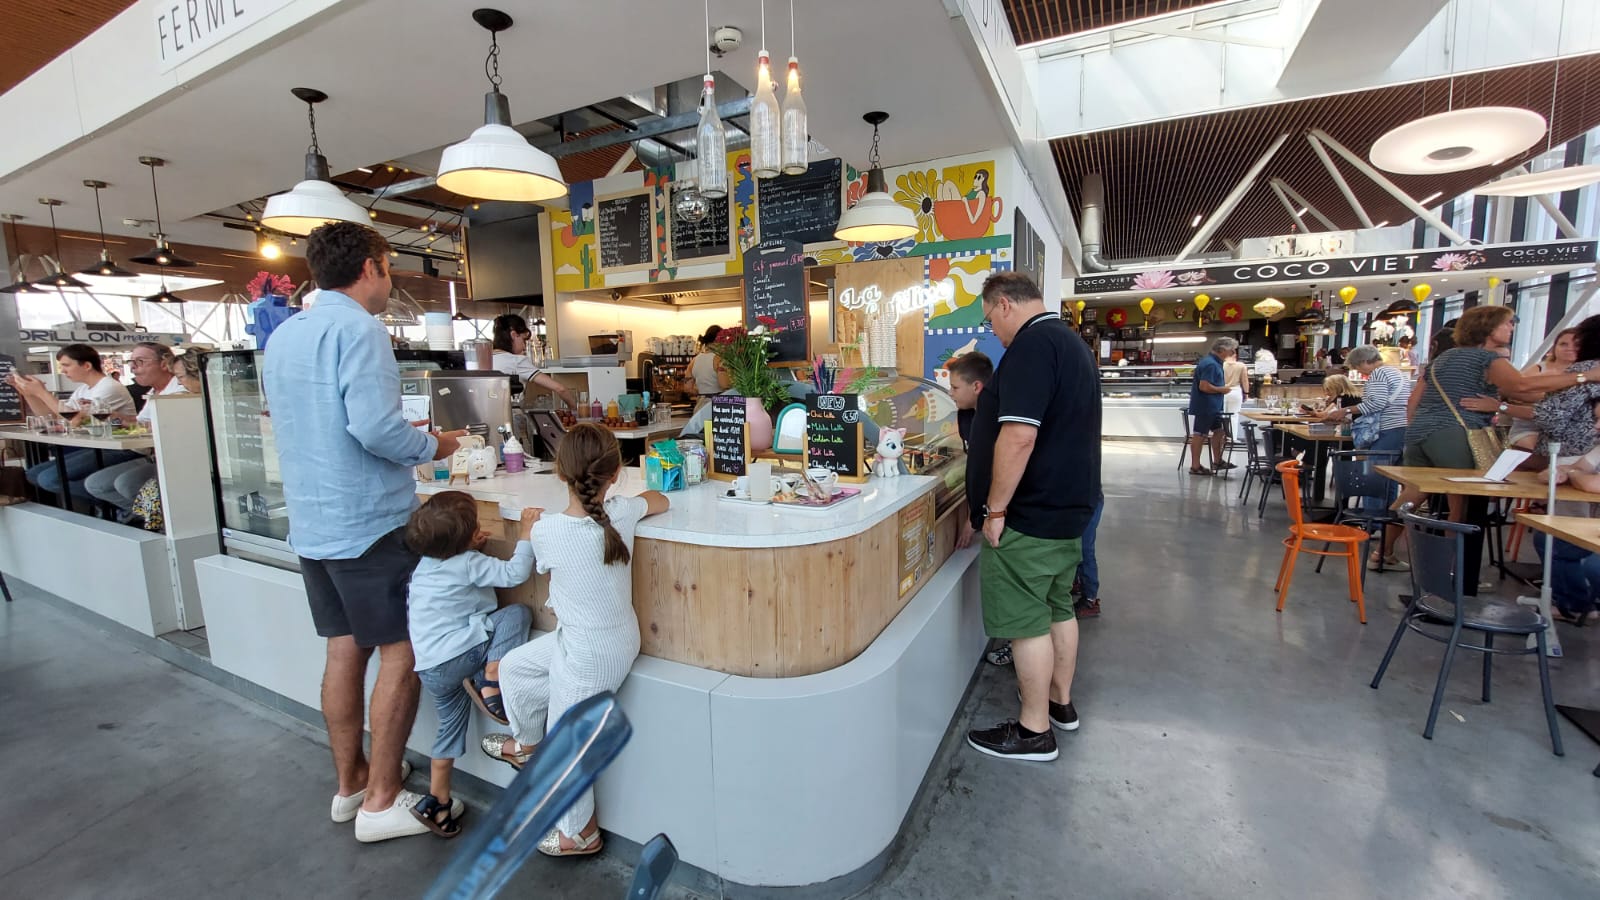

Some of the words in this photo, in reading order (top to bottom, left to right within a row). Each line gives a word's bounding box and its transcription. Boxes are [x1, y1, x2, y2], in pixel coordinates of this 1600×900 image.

[1501, 247, 1549, 258] COCO
[1555, 244, 1589, 255] VIET
[1233, 261, 1331, 280] COCO
[1349, 255, 1420, 273] VIET
[1075, 278, 1106, 287] COCO
[1110, 276, 1131, 284] VIET
[819, 398, 844, 409] NEW
[811, 433, 831, 443] Golden
